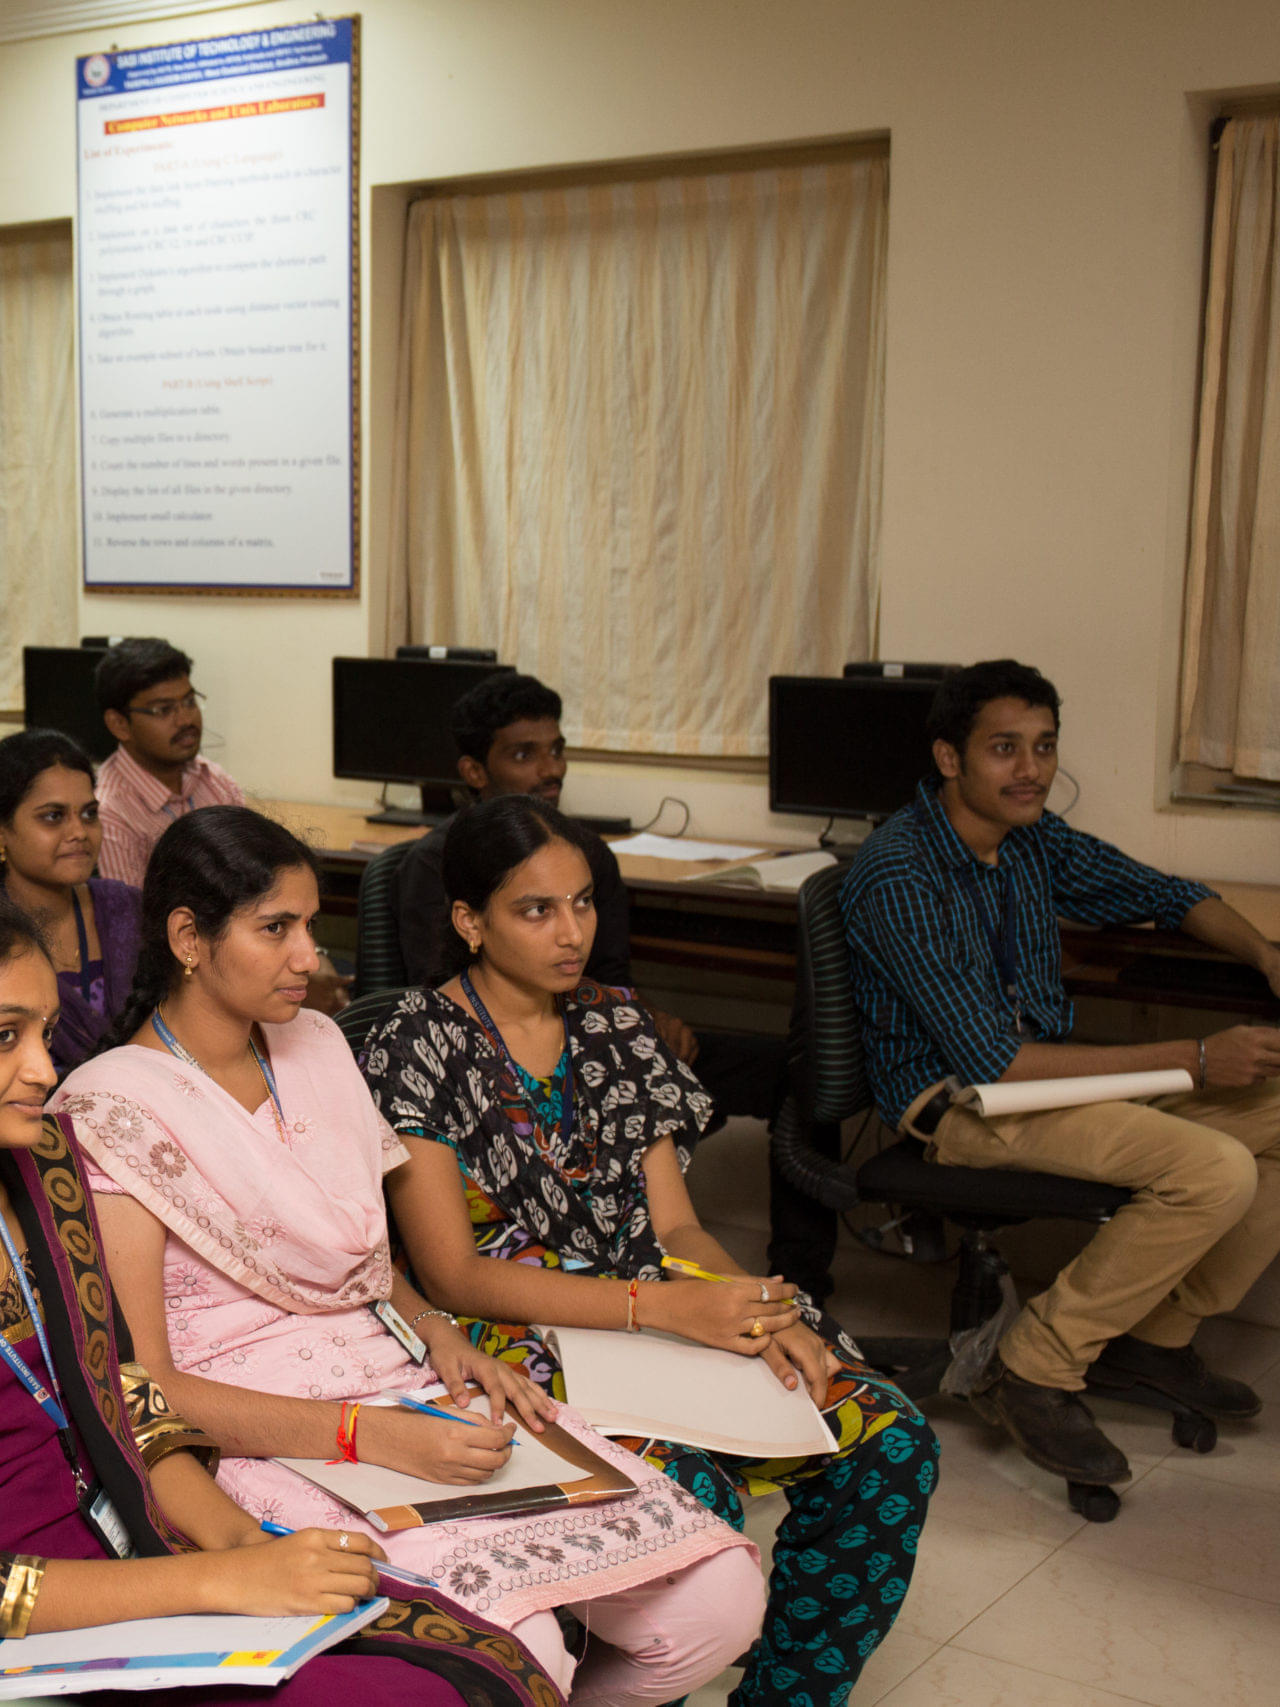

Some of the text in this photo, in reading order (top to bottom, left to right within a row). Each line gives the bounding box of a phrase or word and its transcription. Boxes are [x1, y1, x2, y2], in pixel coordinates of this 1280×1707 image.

[137, 46, 182, 66] INSTITUTE
[198, 34, 260, 57] TECHNOLOGY
[270, 22, 337, 46] ENGINEERING
[107, 115, 158, 136] Computer
[160, 108, 209, 127] Networks
[231, 102, 257, 118] Unix
[258, 94, 319, 115] Laboratory
[83, 147, 100, 159] List
[99, 433, 120, 446] Copy
[123, 432, 154, 445] multiple
[157, 432, 174, 442] files
[99, 459, 123, 469] Count
[140, 458, 170, 468] number
[183, 458, 200, 468] lines
[220, 457, 245, 467] words
[247, 458, 279, 470] present
[299, 456, 323, 469] given
[100, 485, 129, 497] Display
[147, 484, 158, 494] list
[184, 484, 200, 494] files
[228, 485, 251, 496] given
[106, 511, 147, 522] Implement
[150, 511, 170, 520] small
[106, 537, 136, 546] Reverse
[152, 537, 172, 546] rows
[191, 537, 225, 546] columns
[470, 993, 494, 1029] INSTITUTE
[4, 1345, 31, 1377] INSTITUTE
[26, 1374, 41, 1390] SASI
